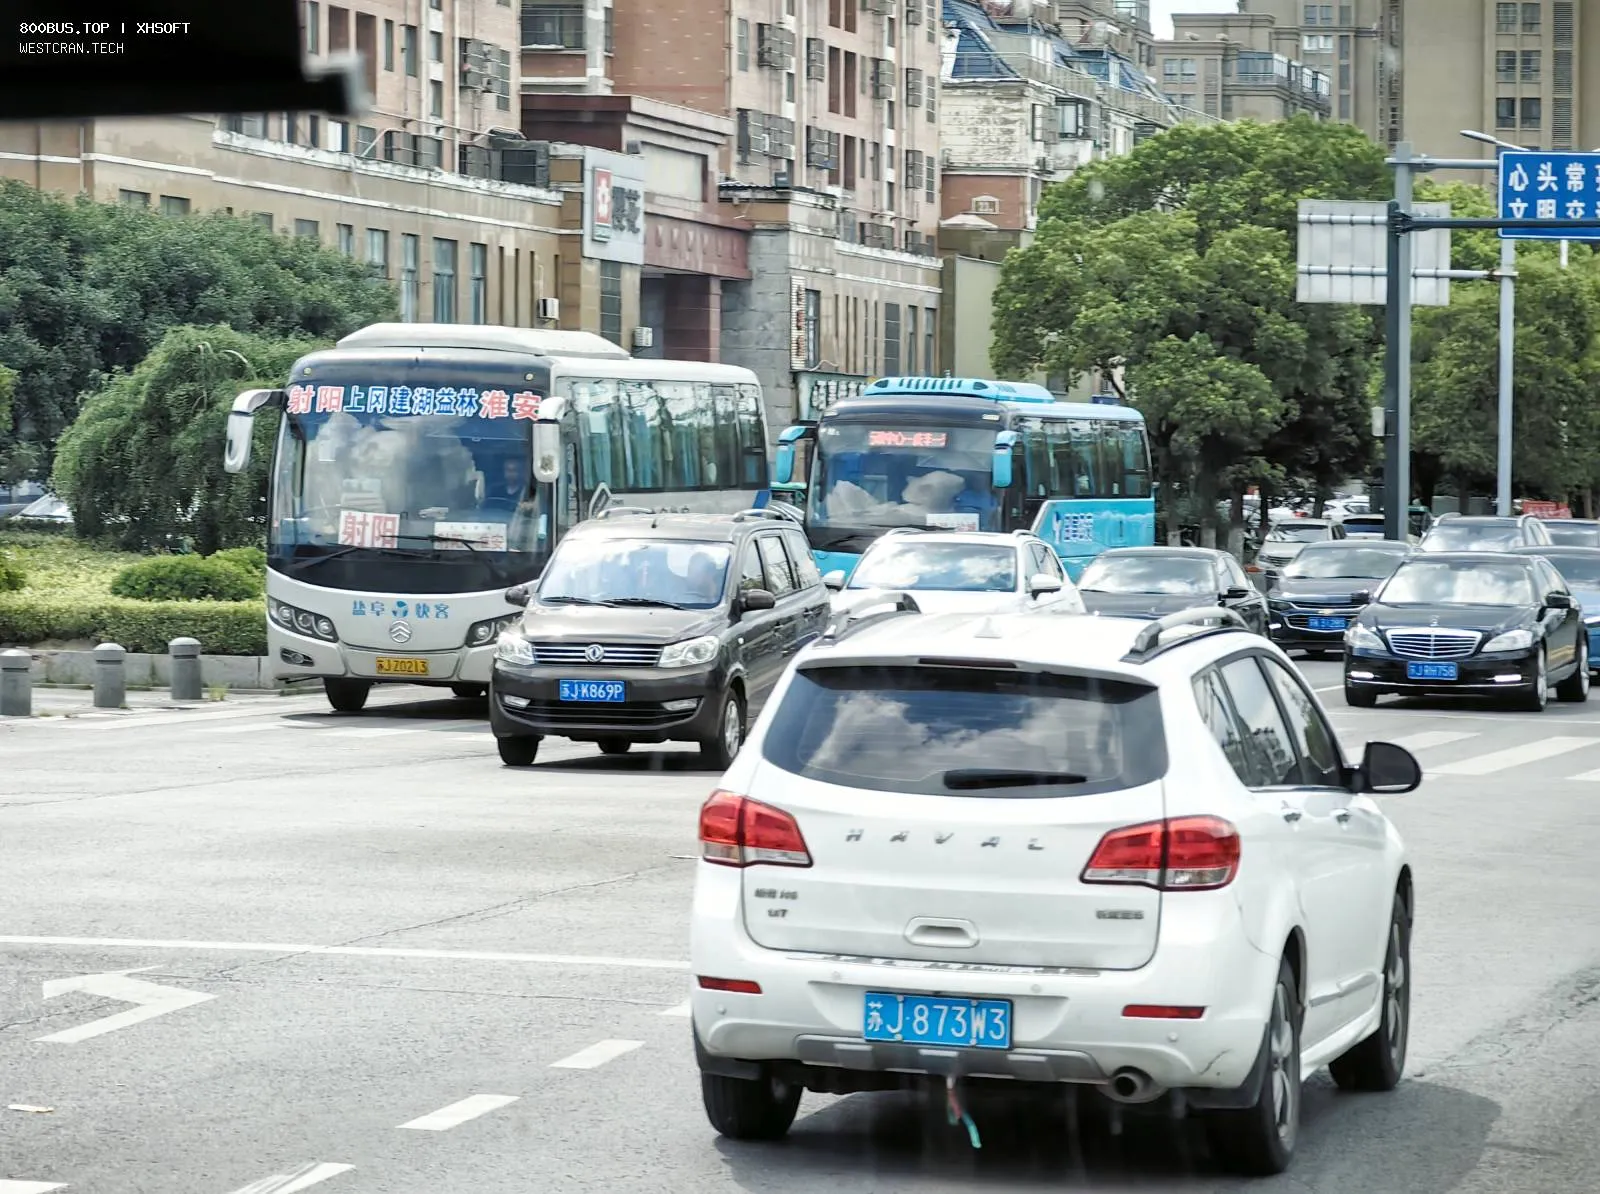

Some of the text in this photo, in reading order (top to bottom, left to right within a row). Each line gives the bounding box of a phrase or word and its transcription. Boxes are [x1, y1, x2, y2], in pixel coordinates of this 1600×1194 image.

[1508, 161, 1600, 192] 心头常
[1508, 198, 1600, 219] 文明交
[342, 512, 398, 548] 射阳
